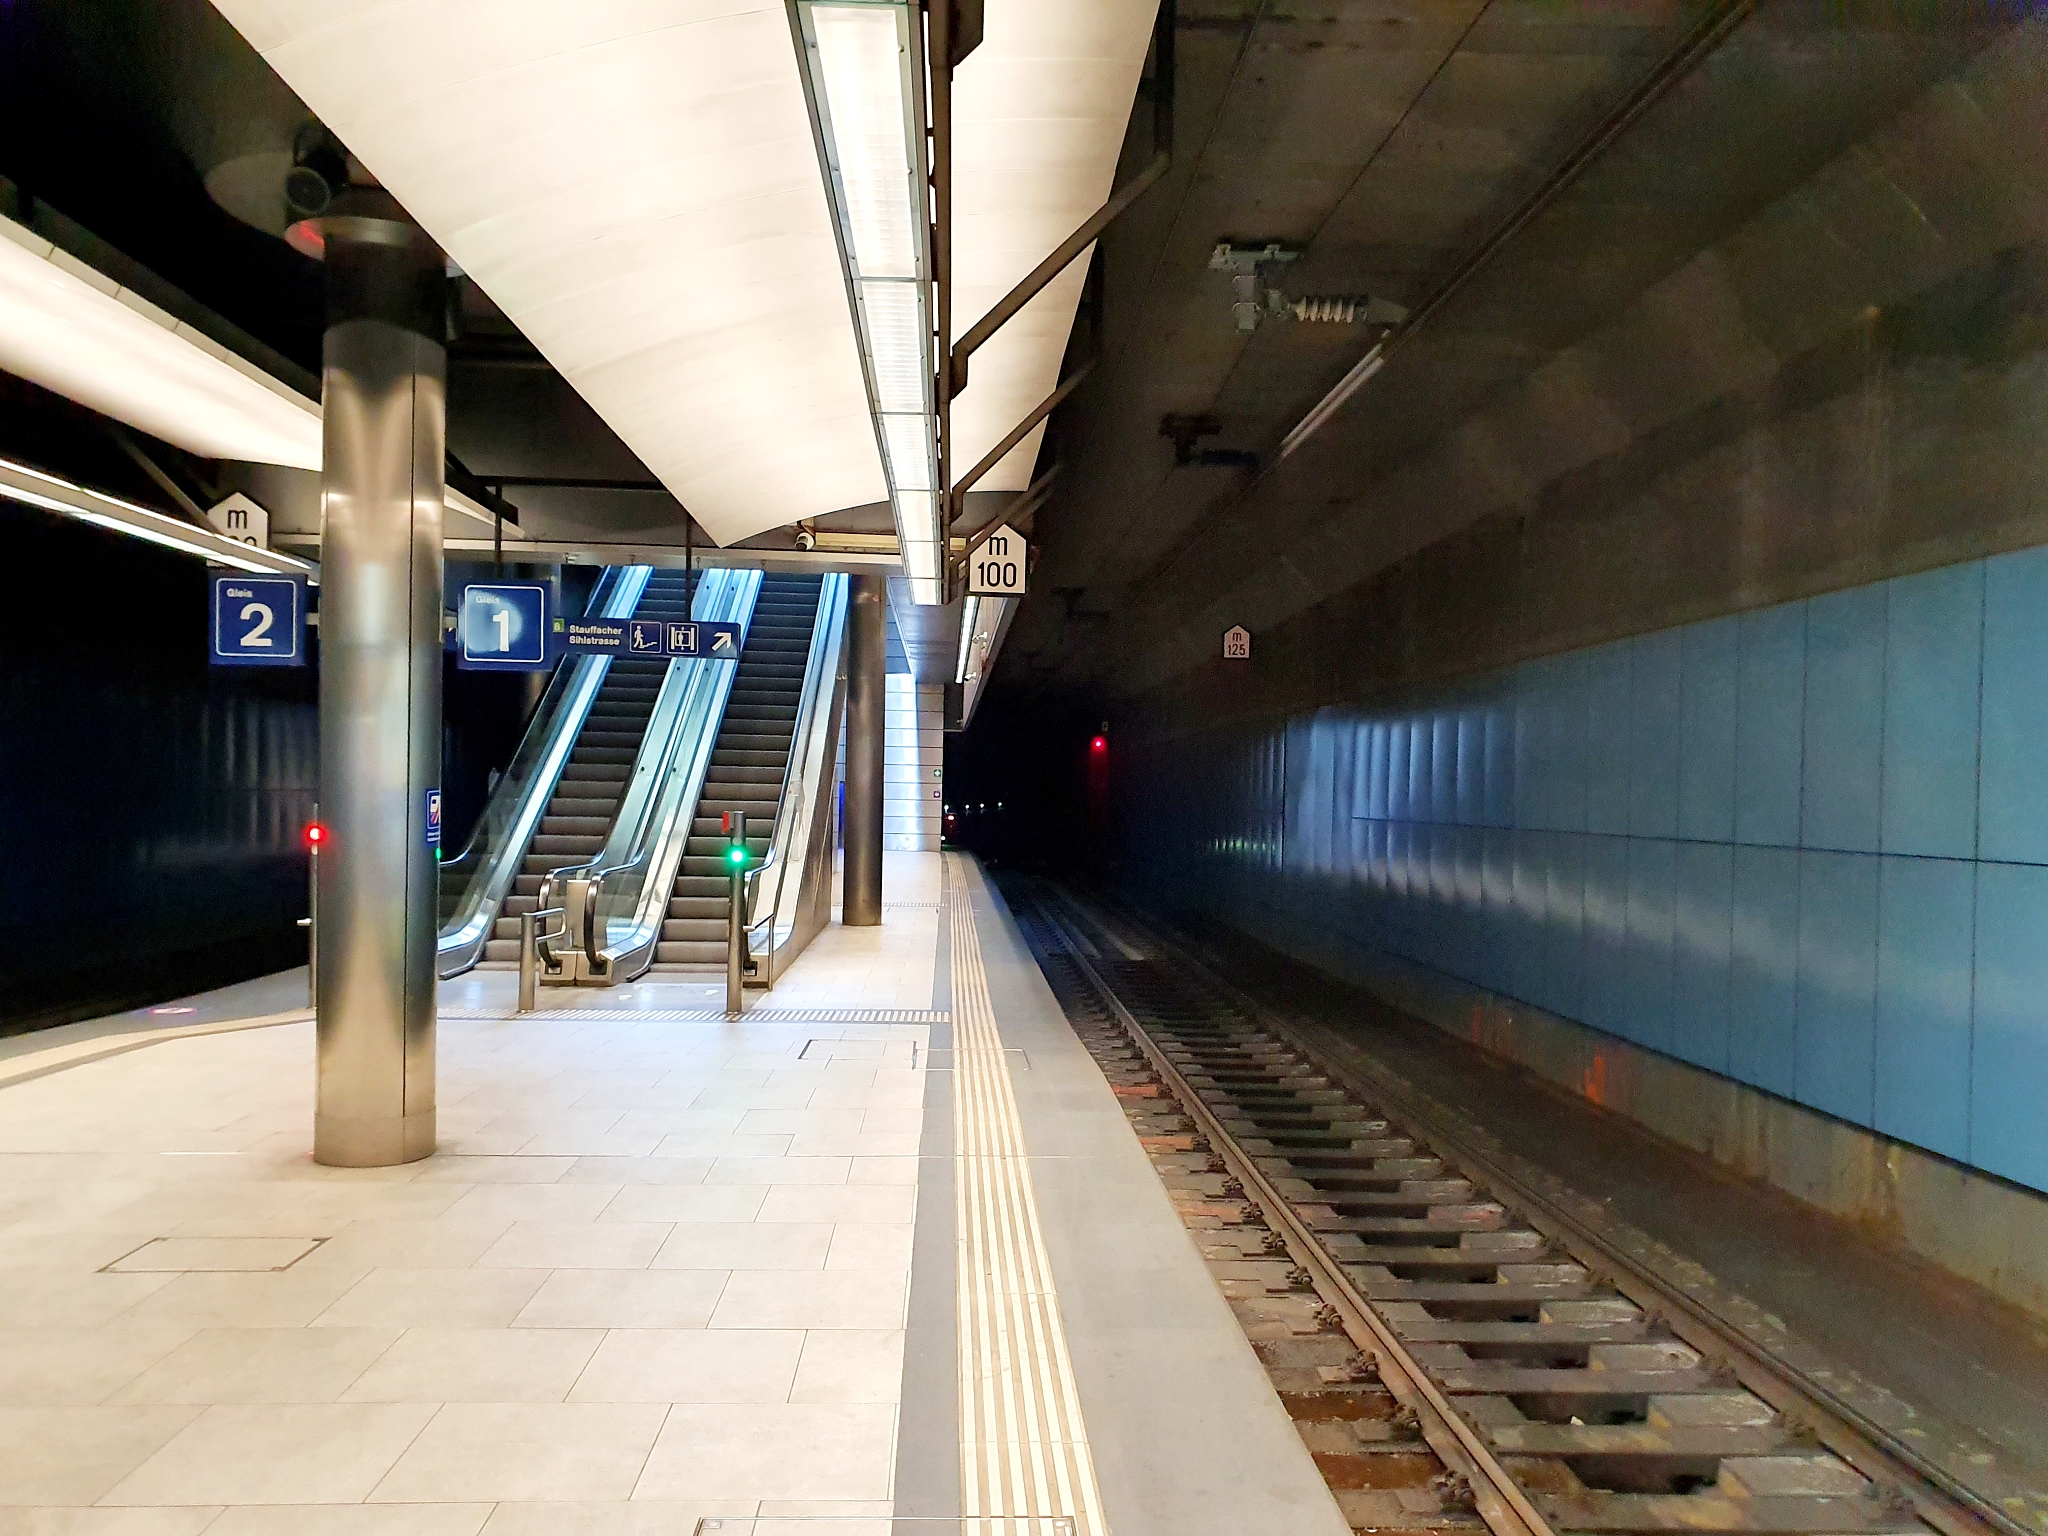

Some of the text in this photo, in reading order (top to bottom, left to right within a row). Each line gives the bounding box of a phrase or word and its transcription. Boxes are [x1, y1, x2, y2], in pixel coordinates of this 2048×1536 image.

[227, 509, 247, 529] m
[989, 536, 1008, 556] m
[978, 561, 1017, 588] 100
[475, 595, 500, 604] Gleis
[240, 603, 272, 646] 2
[492, 609, 509, 652] 1
[569, 624, 623, 635] Stauffacher
[569, 635, 620, 646] Sihlstrasse
[1232, 632, 1242, 642] m
[1227, 643, 1246, 656] 125
